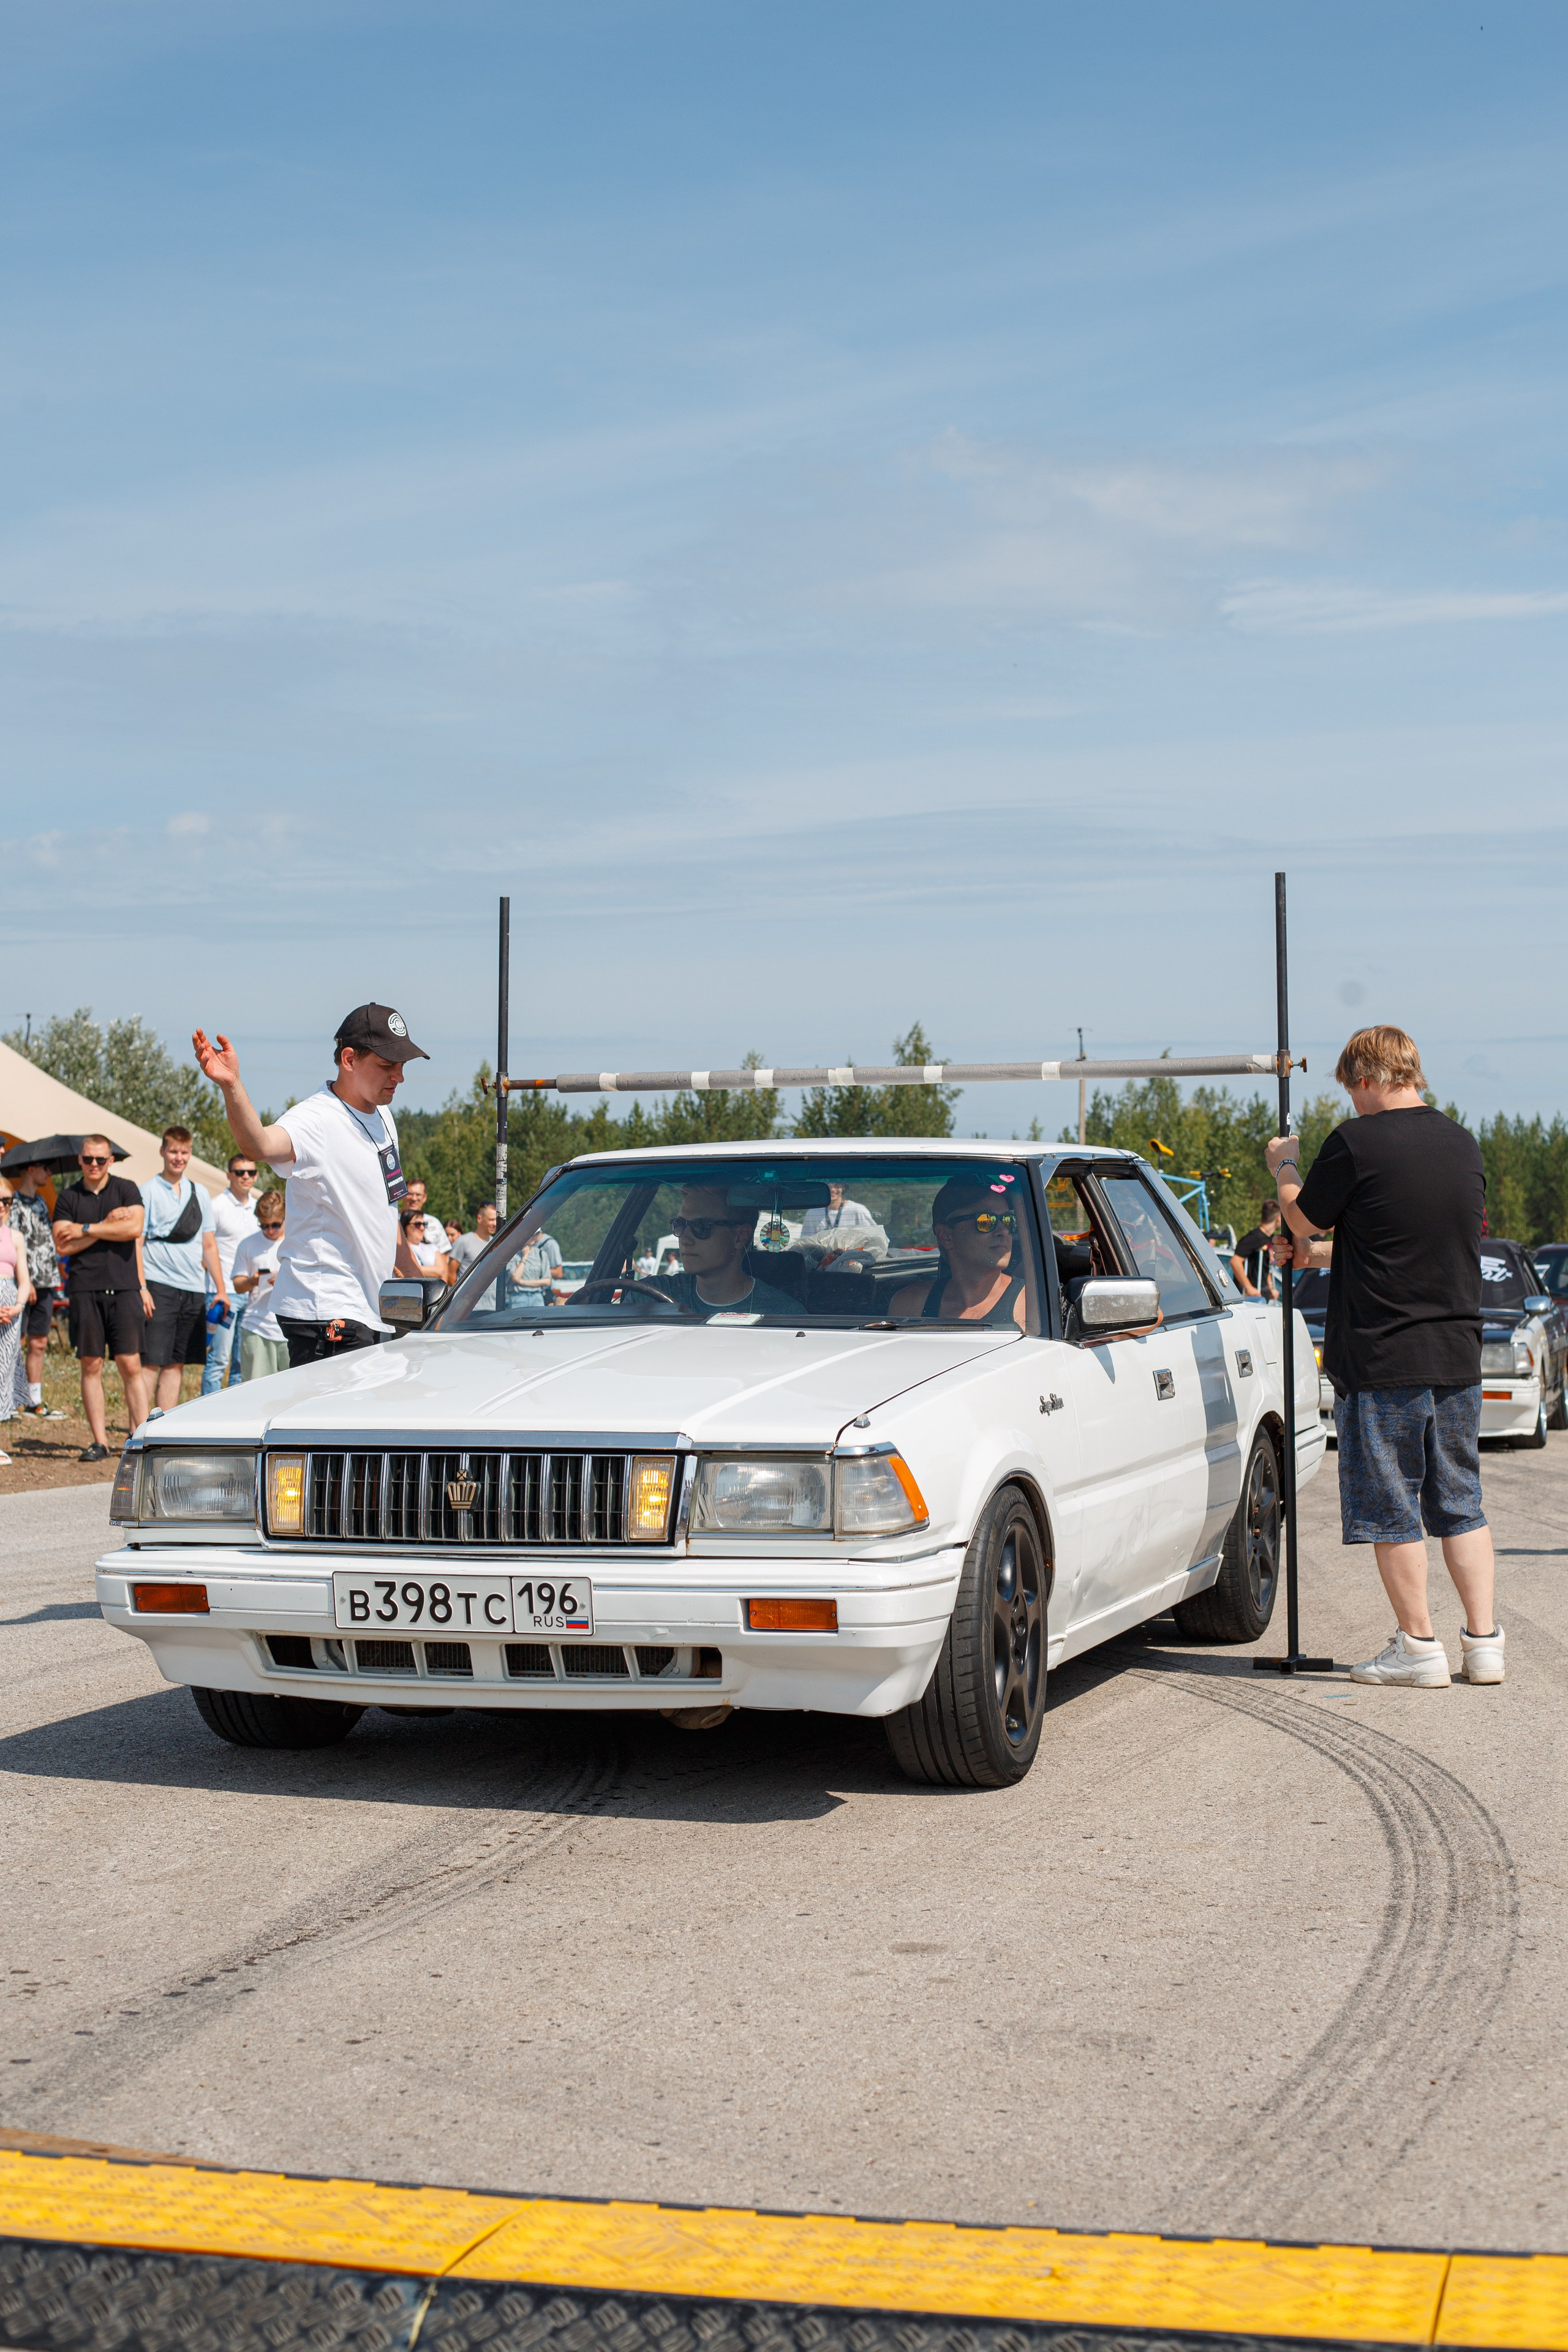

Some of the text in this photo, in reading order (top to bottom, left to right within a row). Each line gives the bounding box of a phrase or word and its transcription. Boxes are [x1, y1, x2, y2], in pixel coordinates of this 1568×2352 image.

[349, 1581, 578, 1625] В398ТС 196
[534, 1616, 564, 1627] RUS
